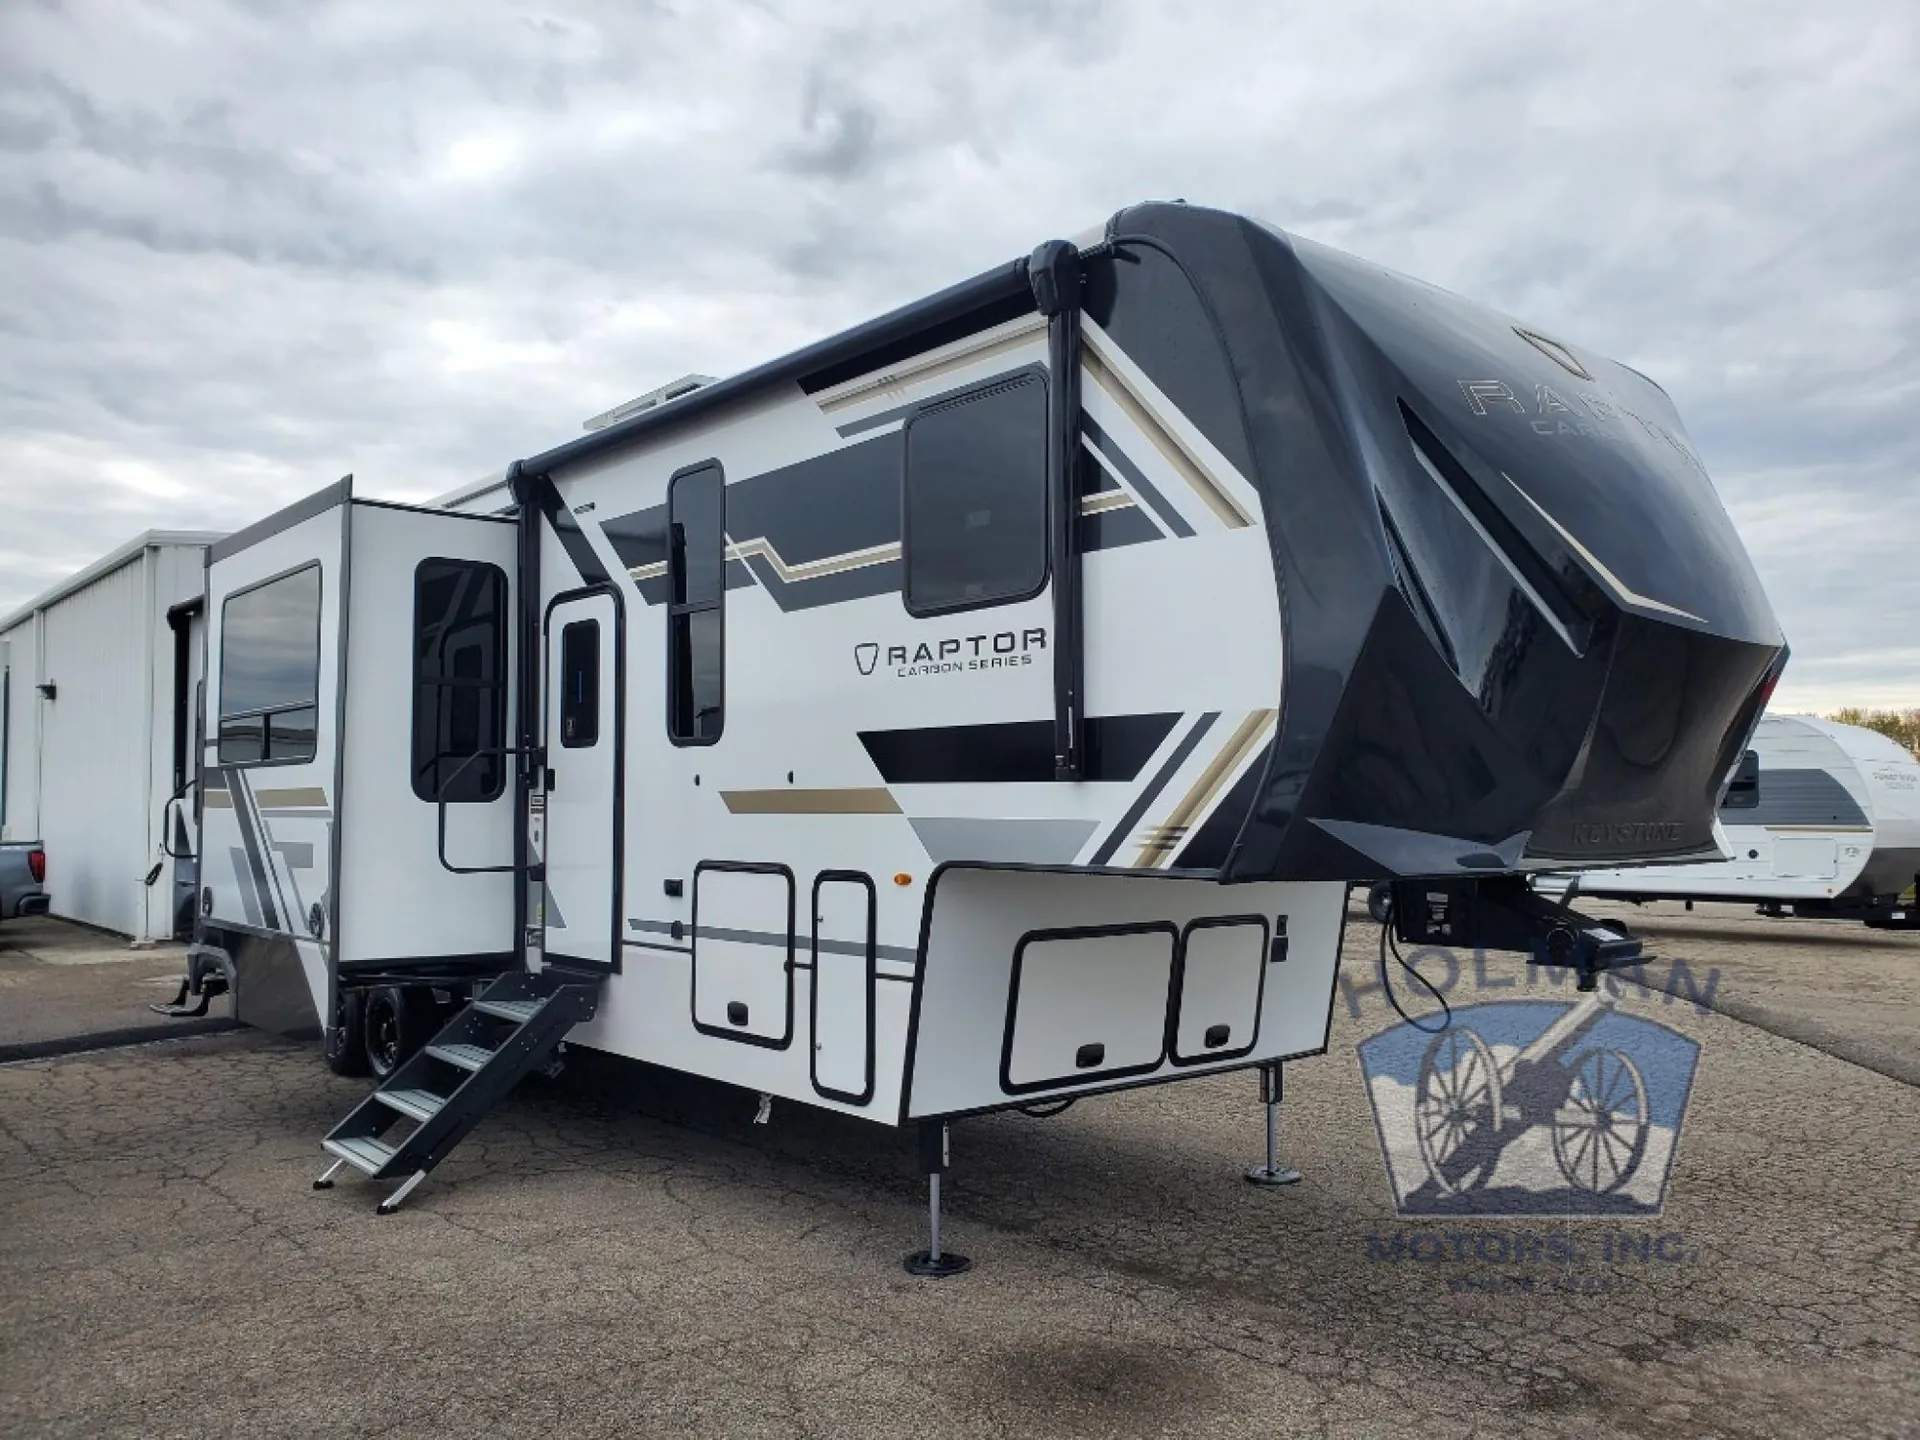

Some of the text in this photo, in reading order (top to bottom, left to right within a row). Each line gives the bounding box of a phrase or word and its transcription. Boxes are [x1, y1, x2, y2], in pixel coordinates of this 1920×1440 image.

[888, 628, 1046, 666] RAPTOR
[898, 654, 1032, 677] CARBON SERIES
